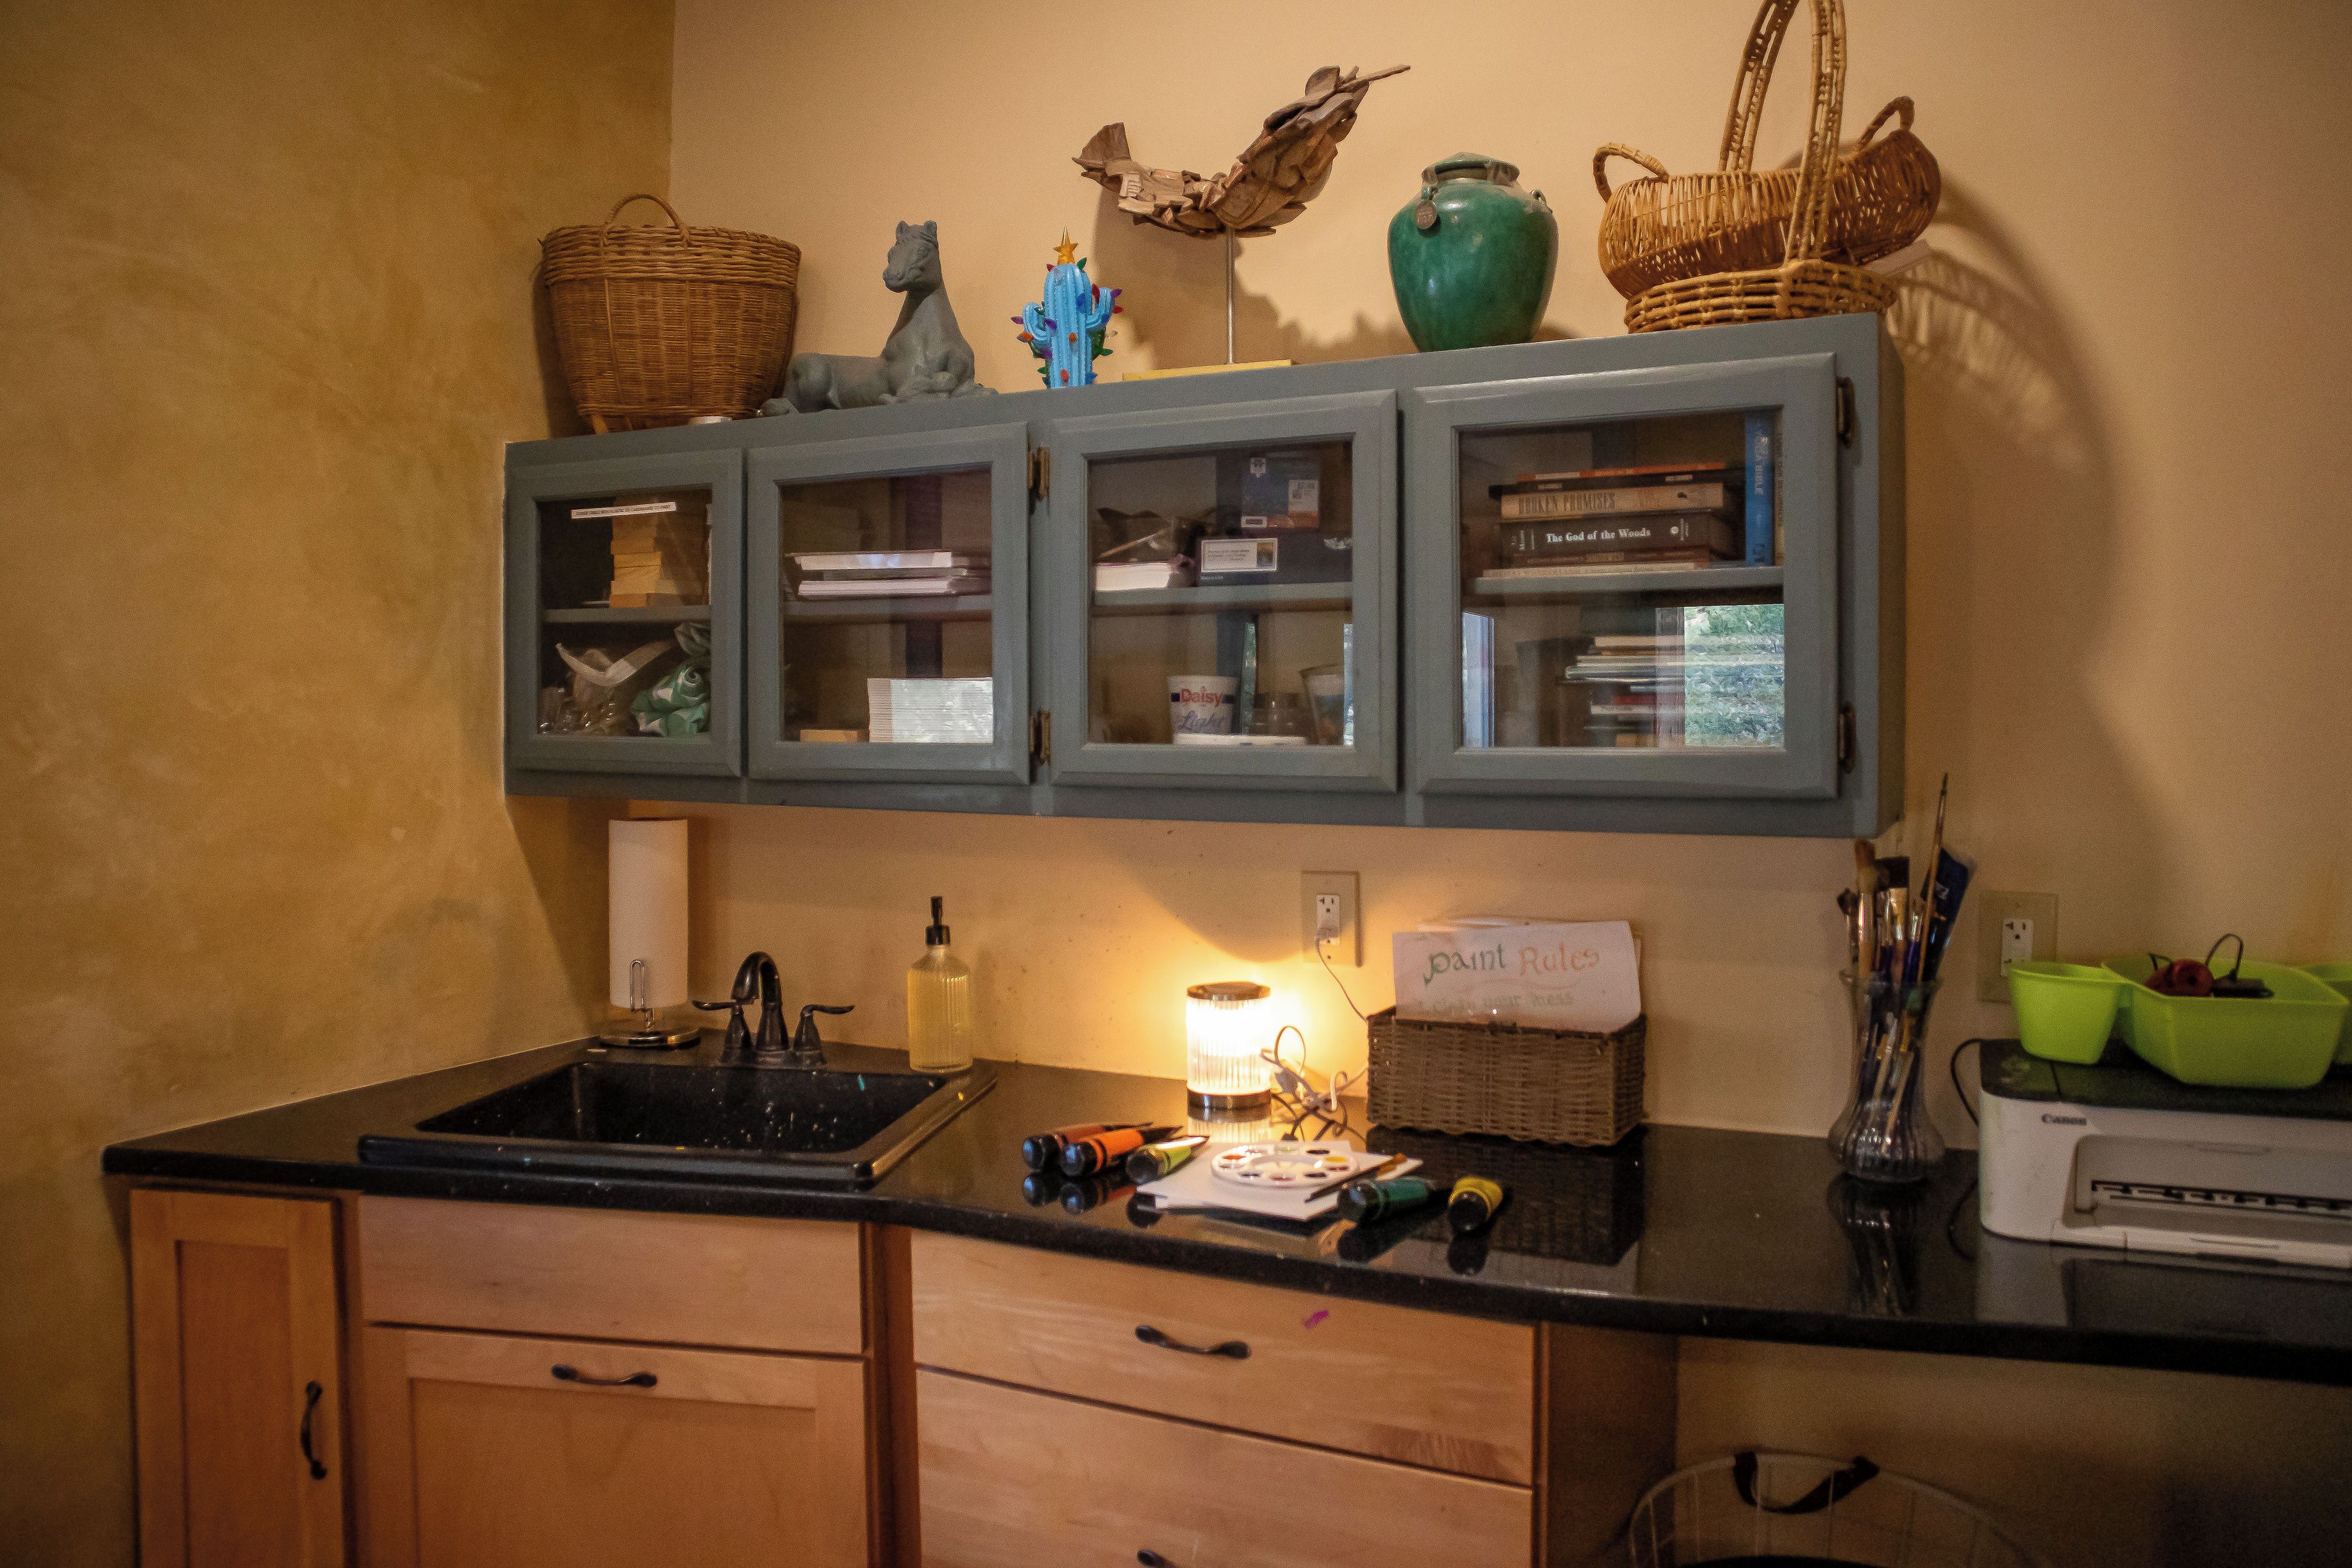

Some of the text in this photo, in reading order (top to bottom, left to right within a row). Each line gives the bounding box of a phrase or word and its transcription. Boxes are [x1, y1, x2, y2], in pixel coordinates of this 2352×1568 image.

[1546, 533, 1563, 543] The
[1565, 532, 1584, 542] God
[1587, 531, 1598, 540] of
[1601, 530, 1616, 540] the
[1618, 527, 1652, 538] Woods
[1180, 687, 1224, 706] Daisy
[1518, 941, 1599, 975] Rules
[2040, 1113, 2087, 1126] Canon
